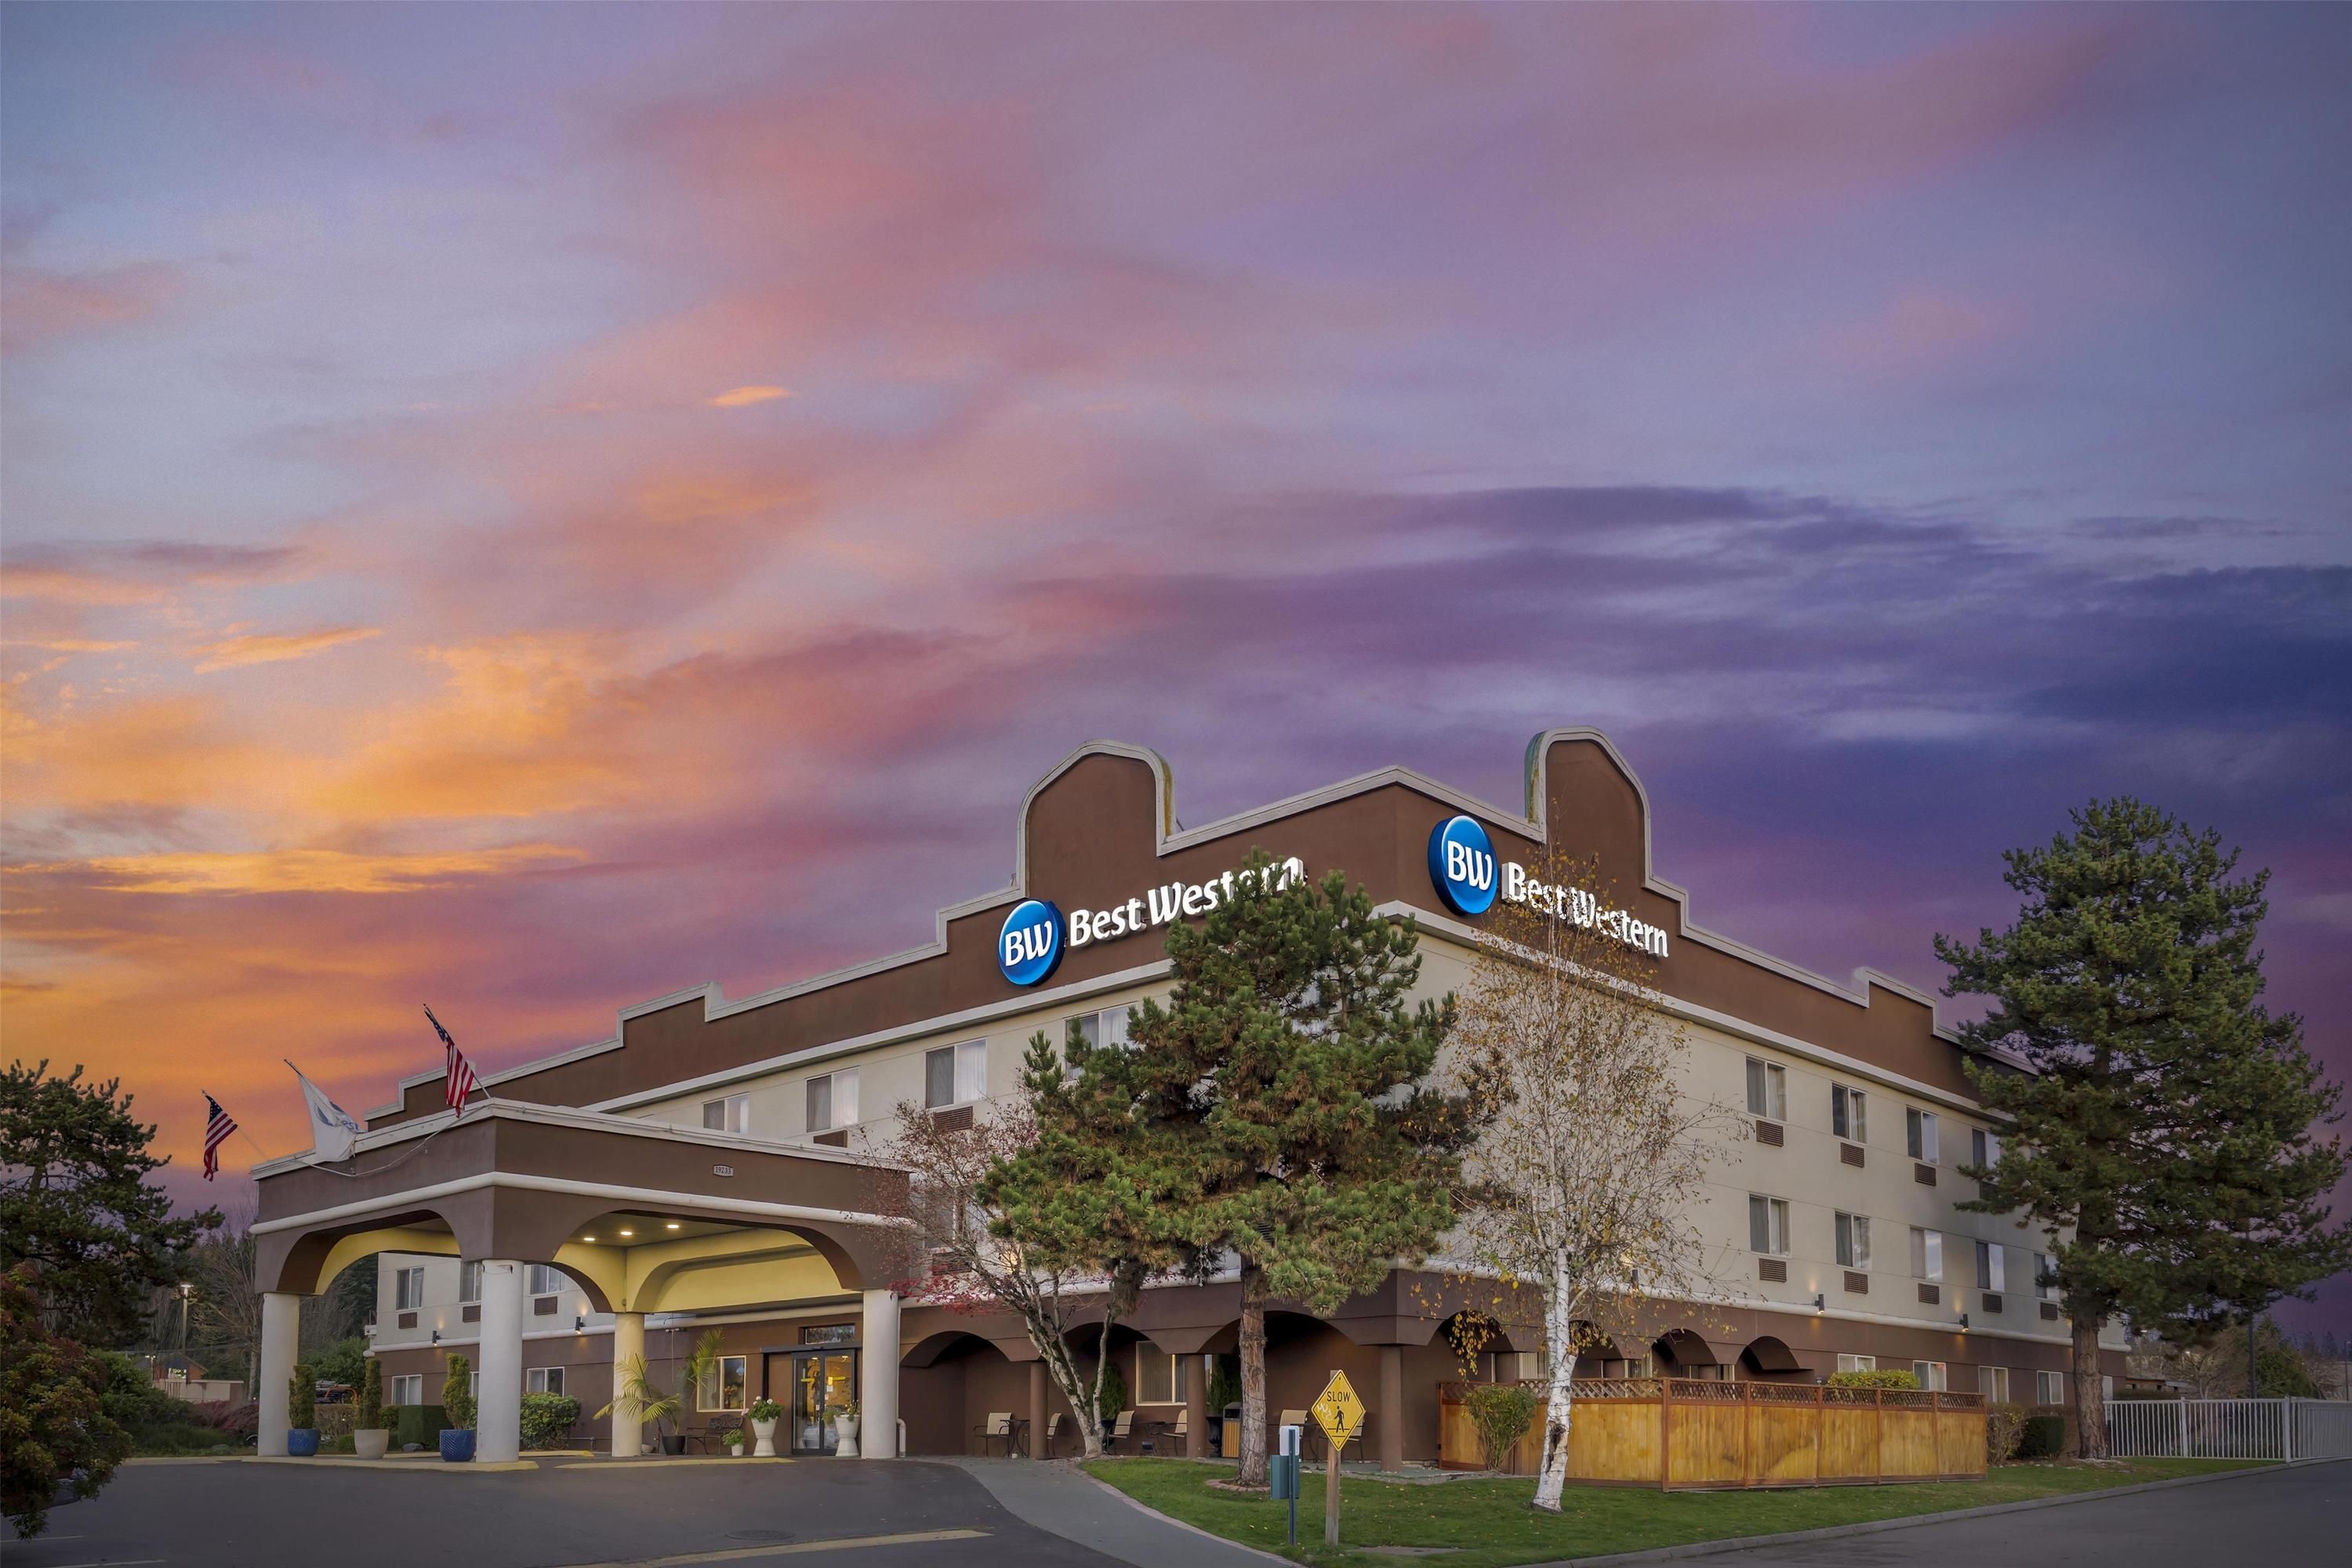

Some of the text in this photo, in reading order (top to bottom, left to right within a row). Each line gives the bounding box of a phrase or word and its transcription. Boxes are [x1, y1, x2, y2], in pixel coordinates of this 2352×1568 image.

[1447, 840, 1493, 891] BW
[1069, 897, 1146, 947] Best
[1503, 862, 1668, 958] Best Western
[1005, 920, 1052, 967] BW
[1327, 1391, 1351, 1402] SLOW
